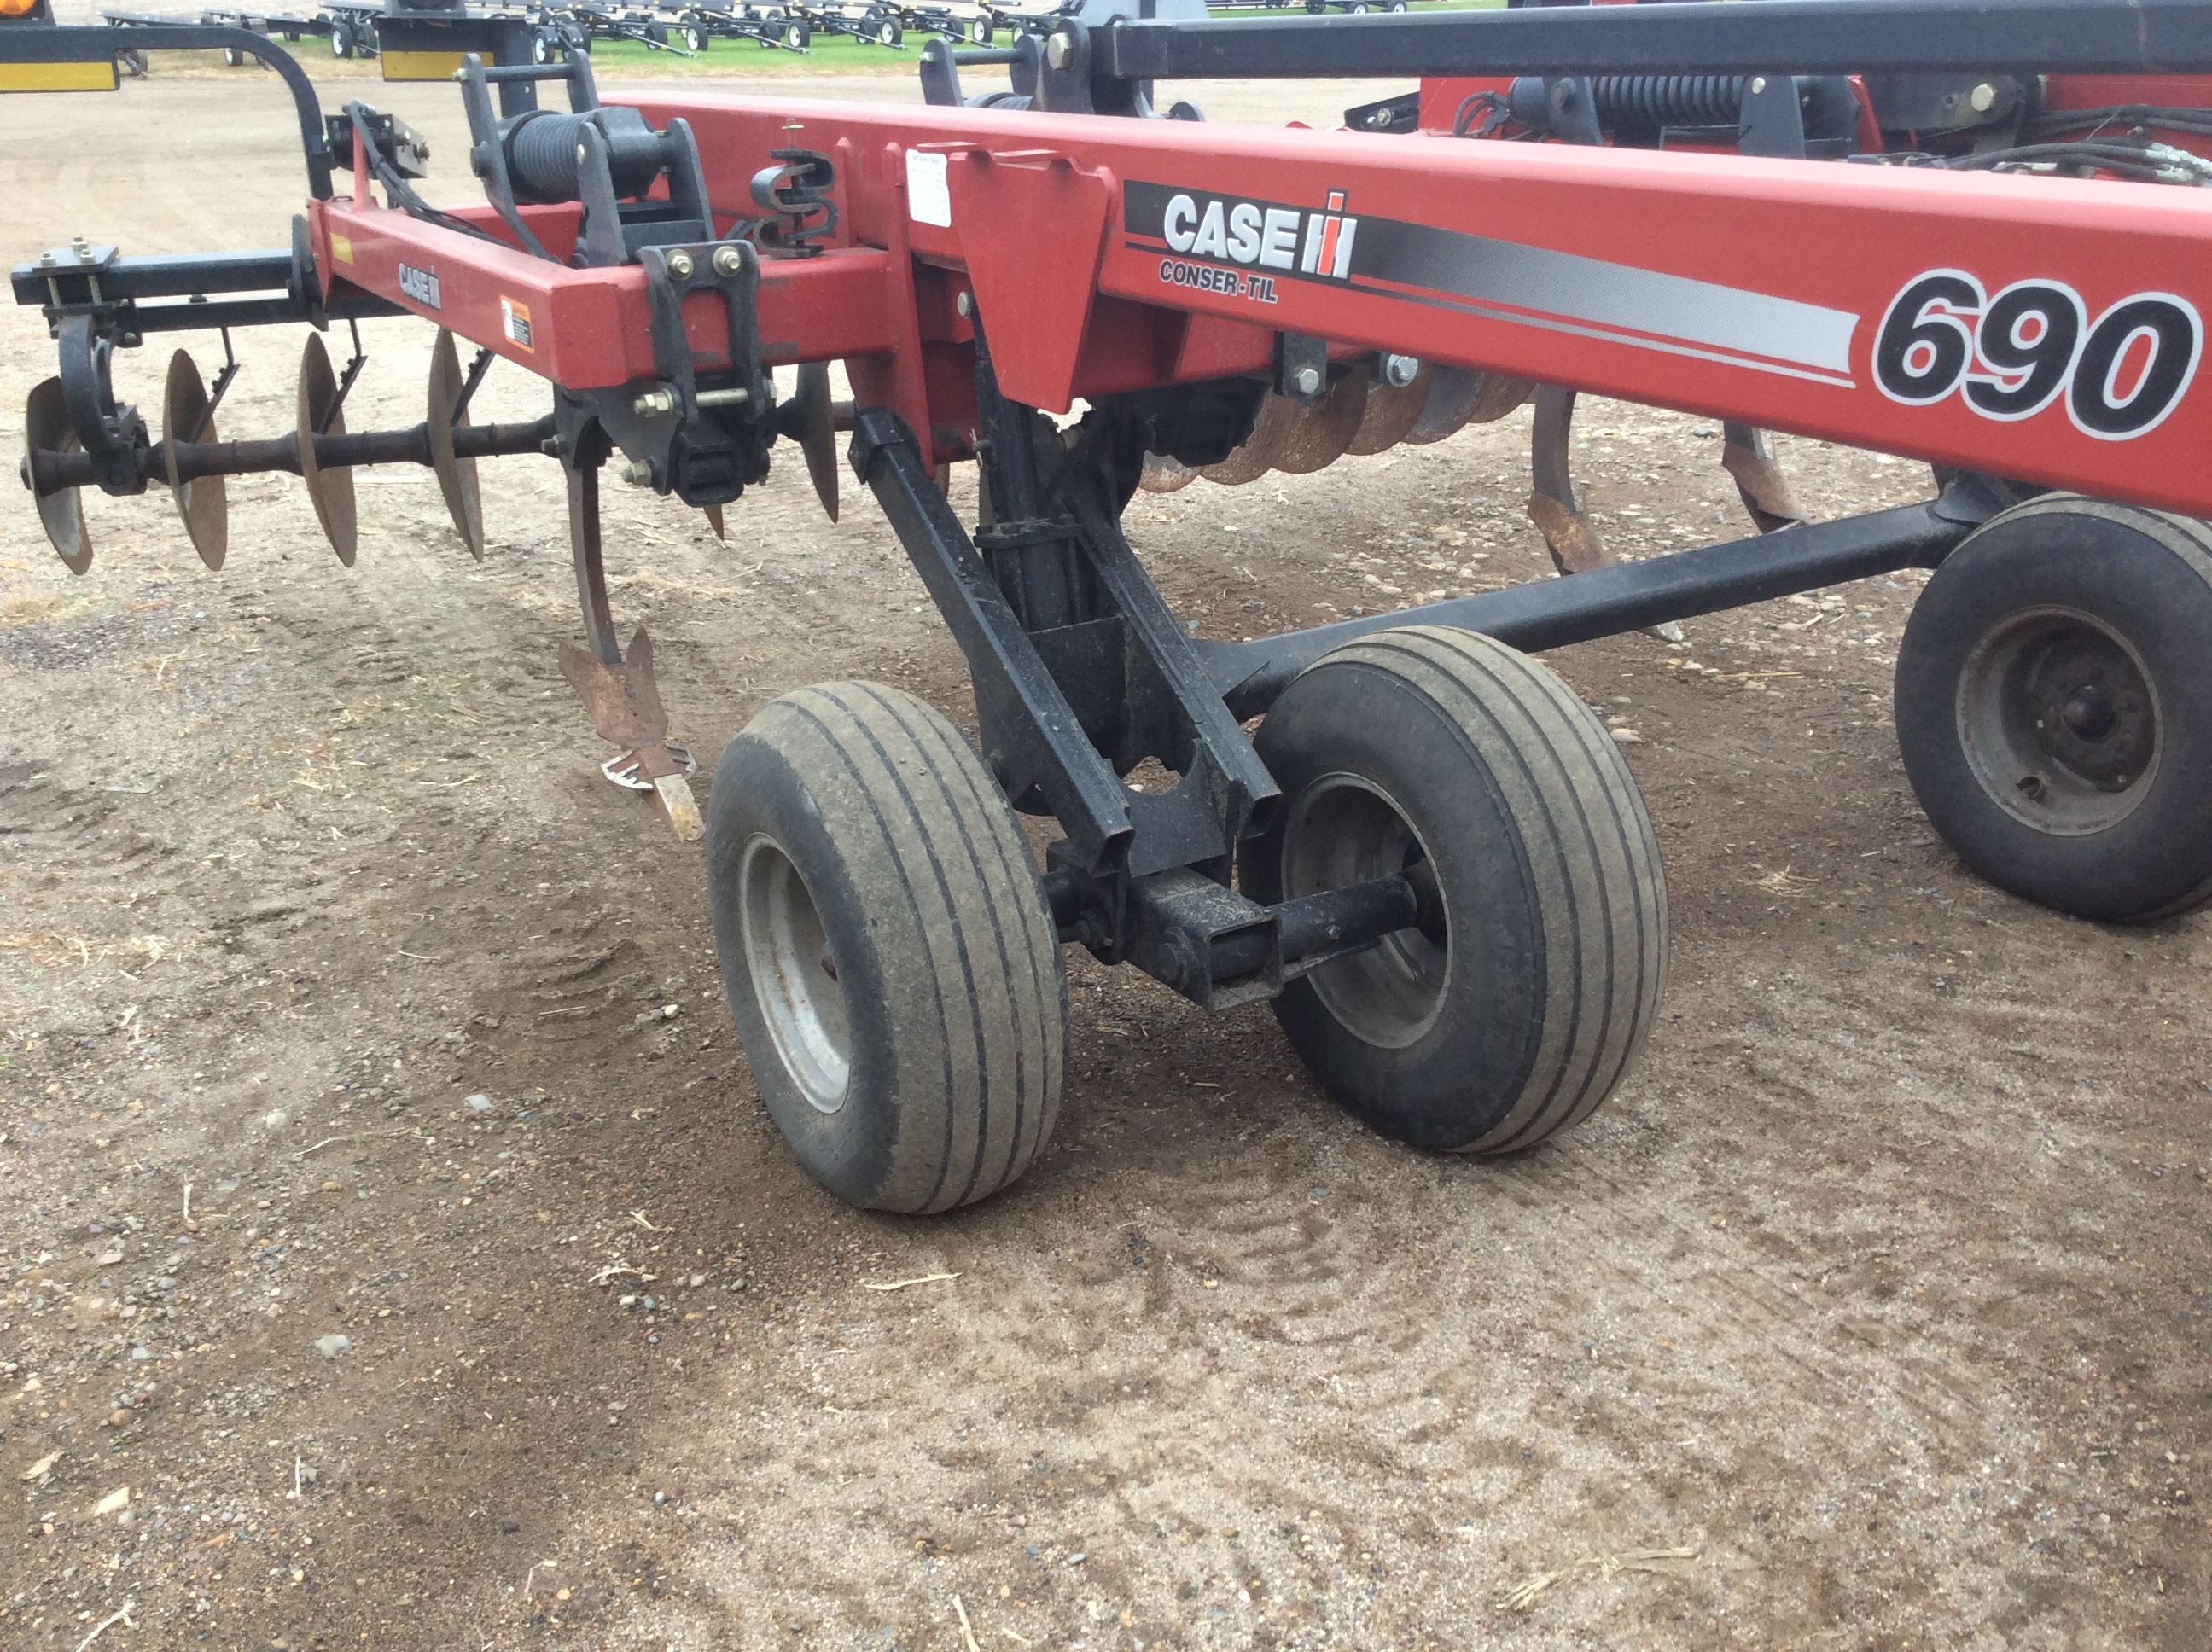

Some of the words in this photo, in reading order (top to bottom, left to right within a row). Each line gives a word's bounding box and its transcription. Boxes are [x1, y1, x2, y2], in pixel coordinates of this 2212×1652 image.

[1163, 194, 1301, 270] CASE
[399, 262, 429, 304] CASE
[1160, 259, 1278, 305] CONSER-TIL
[1871, 267, 2204, 442] 690
